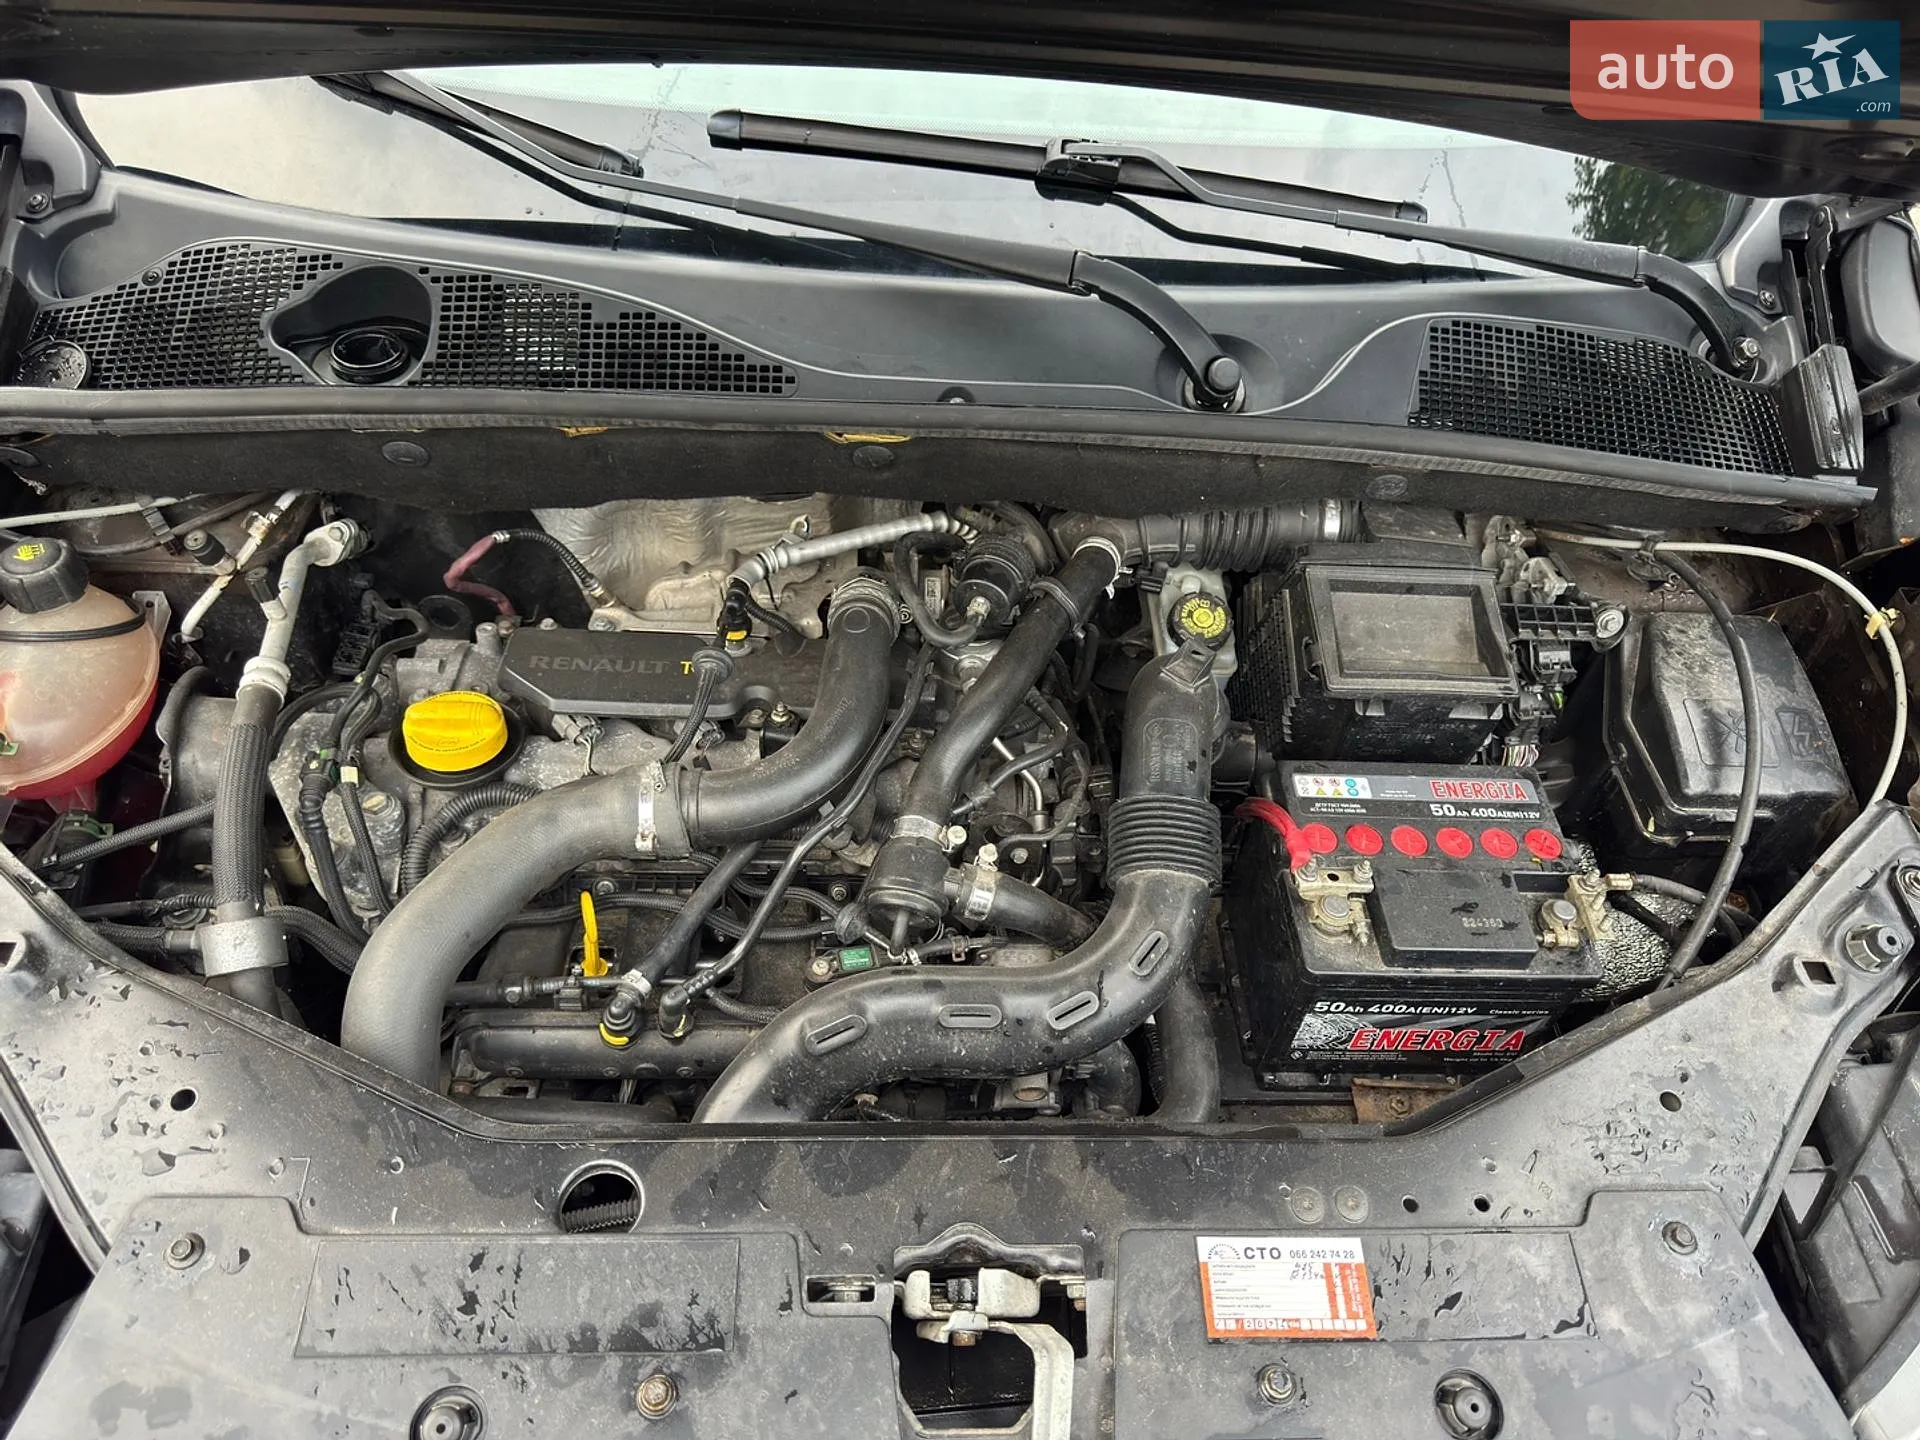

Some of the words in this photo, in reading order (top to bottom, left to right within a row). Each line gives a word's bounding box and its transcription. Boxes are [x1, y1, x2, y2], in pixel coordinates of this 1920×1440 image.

[528, 655, 671, 674] RENAULT
[1430, 780, 1529, 801] ENERGIA
[1429, 803, 1471, 817] 50Ah
[1314, 1001, 1364, 1013] 50Ah
[1347, 1029, 1526, 1051] ENERGIA
[1310, 1249, 1327, 1259] 242
[1329, 1250, 1341, 1259] 74
[1342, 1249, 1356, 1260] 28
